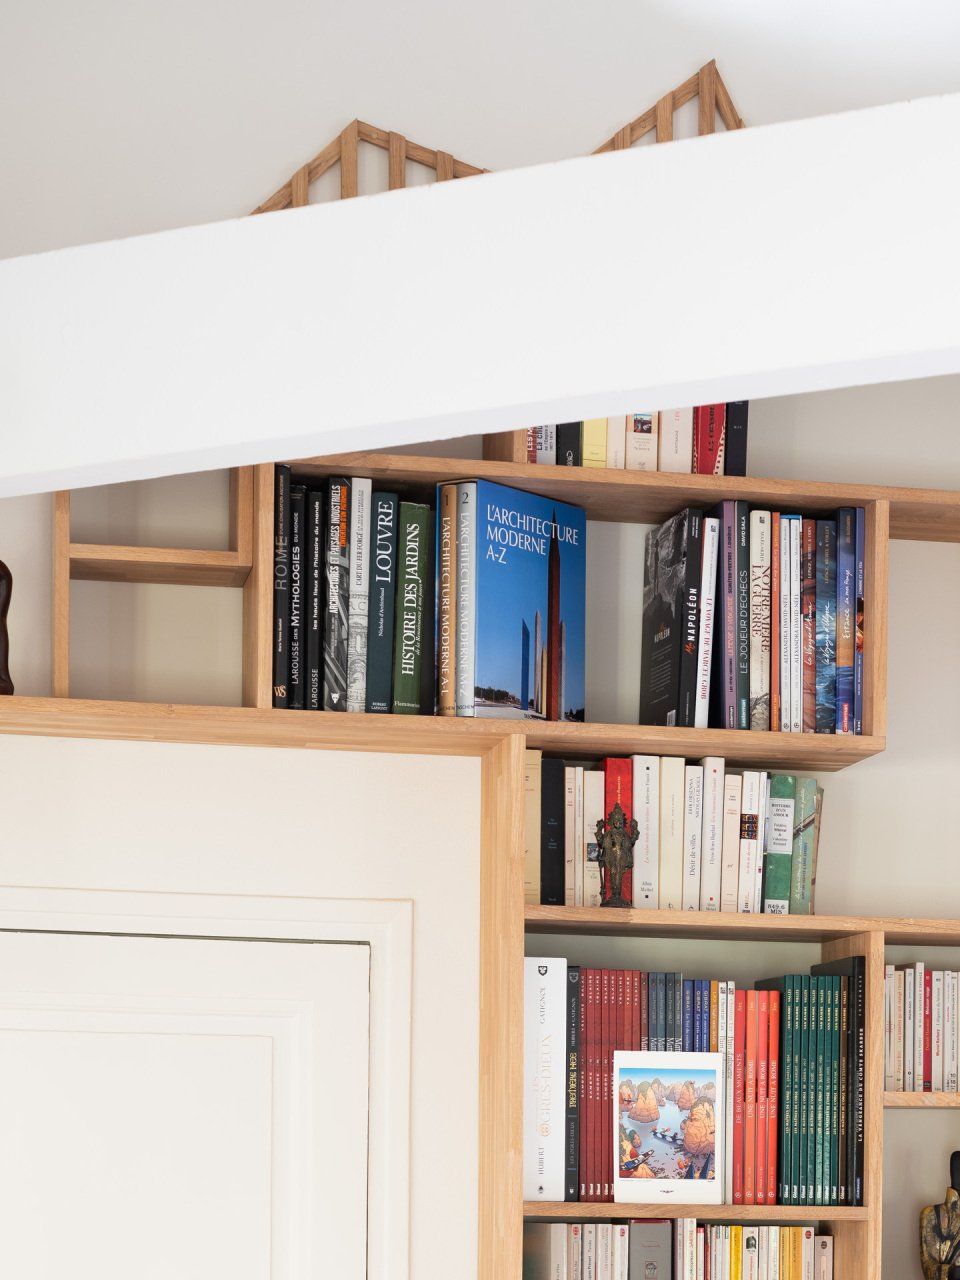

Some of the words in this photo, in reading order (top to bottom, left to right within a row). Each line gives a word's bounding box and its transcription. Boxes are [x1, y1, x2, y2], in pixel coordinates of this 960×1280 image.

[330, 485, 341, 524] INDUSTRIELS
[444, 494, 449, 506] 1
[462, 492, 469, 504] 2
[314, 526, 320, 534] du
[330, 525, 340, 554] PAYSAGES
[376, 501, 393, 583] LOUVRE
[486, 526, 546, 556] MODERNE
[487, 504, 579, 546] L'ARCHITECTURE
[275, 535, 287, 590] ROME
[314, 569, 320, 578] de
[330, 556, 339, 564] ET
[404, 524, 422, 584] JARDINS
[442, 517, 450, 606] L'ARCHITECTURE
[460, 513, 470, 602] L'ARCHITECTURE
[486, 547, 508, 564] A-Z
[752, 564, 761, 582] LA
[290, 546, 300, 626] MYTHOLOGIES
[328, 565, 340, 614] ARCHITECTURES
[404, 584, 418, 608] DES
[740, 570, 748, 617] D'ECHECS
[686, 588, 698, 641] NAPOLÉON
[752, 584, 761, 638] GUERRE
[402, 612, 416, 675] HISTOIRE
[442, 612, 450, 671] MODERNE
[459, 608, 469, 668] MODERNE
[740, 620, 748, 660] JOUEUR
[290, 642, 299, 684] LAROUSSE
[740, 662, 748, 674] LE
[311, 668, 319, 708] LAROUSSE
[736, 1114, 742, 1124] DE
